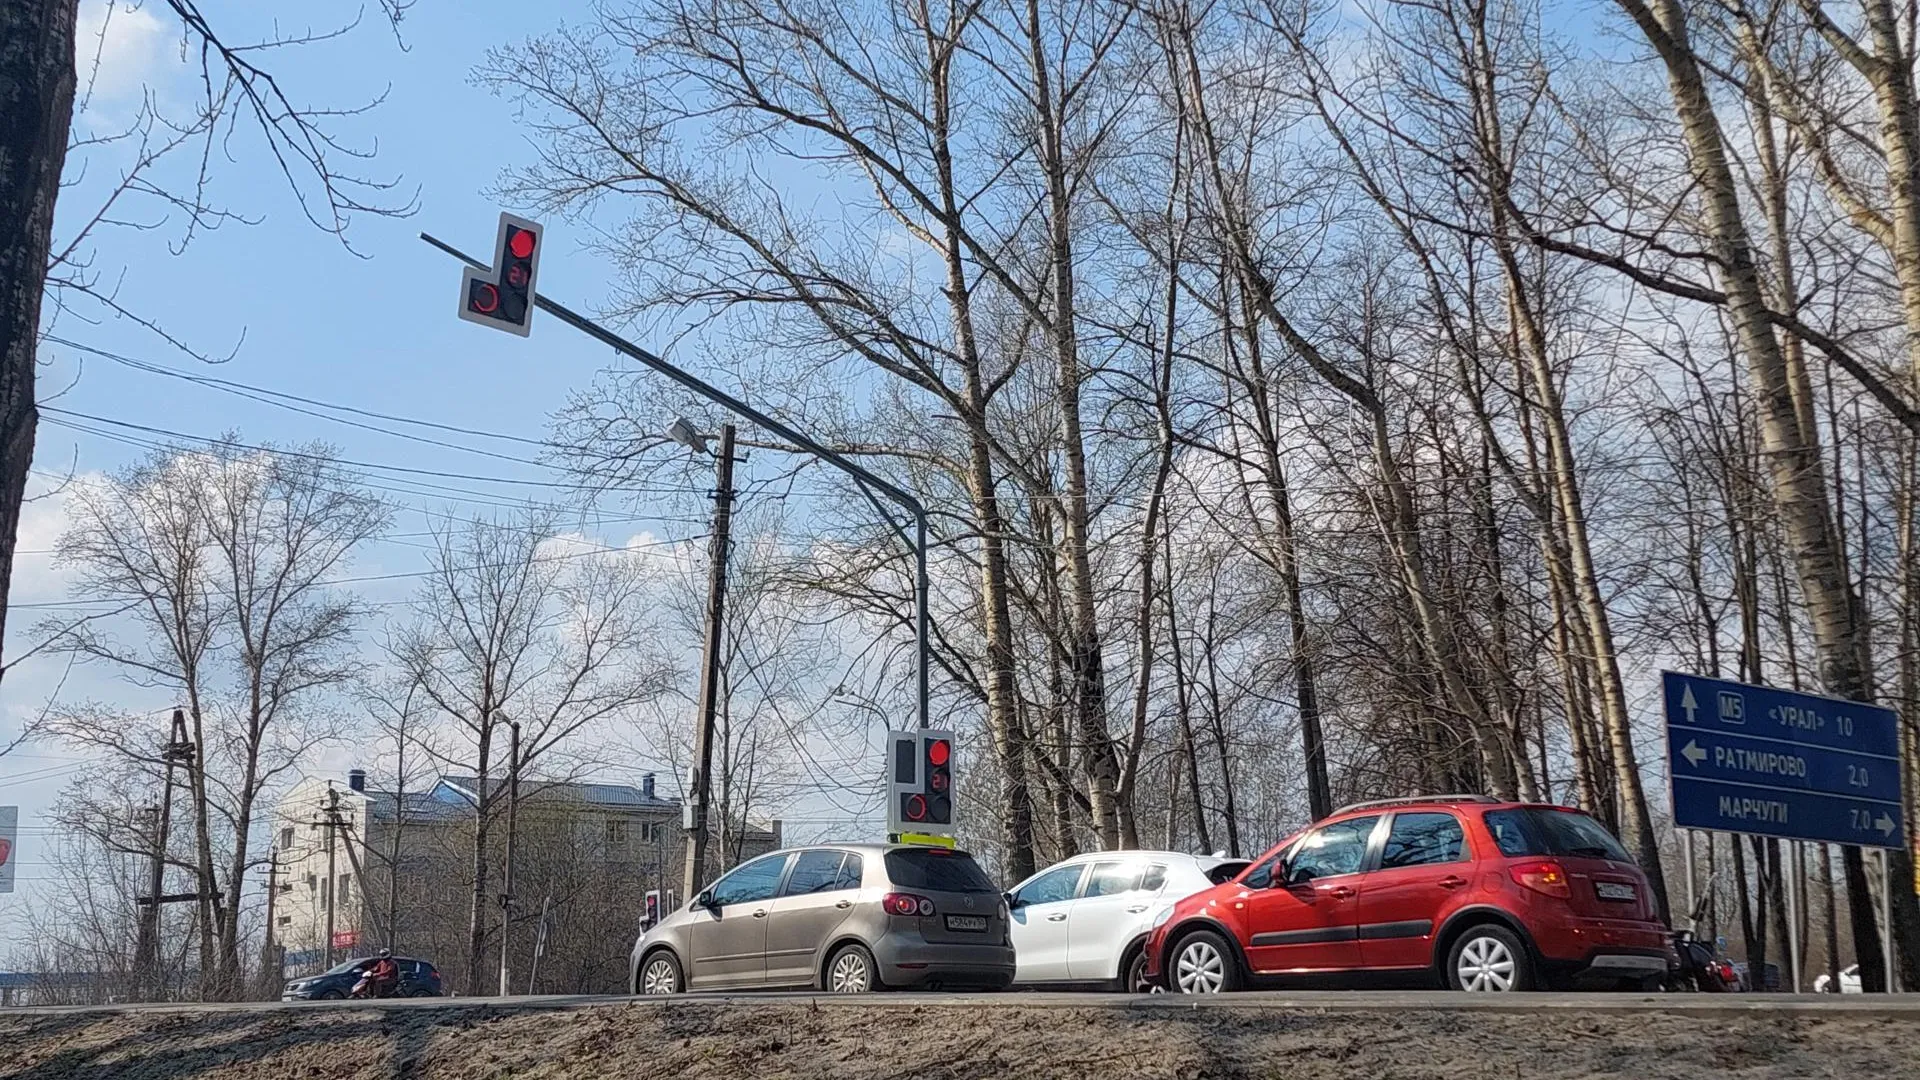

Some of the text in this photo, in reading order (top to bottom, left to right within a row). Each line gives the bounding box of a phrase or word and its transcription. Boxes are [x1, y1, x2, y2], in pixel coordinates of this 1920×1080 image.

[1836, 715, 1853, 737] 10
[1715, 746, 1869, 788] РАТМИРОВО 2,0
[1719, 795, 1871, 830] МАРЧУГИ 7,0
